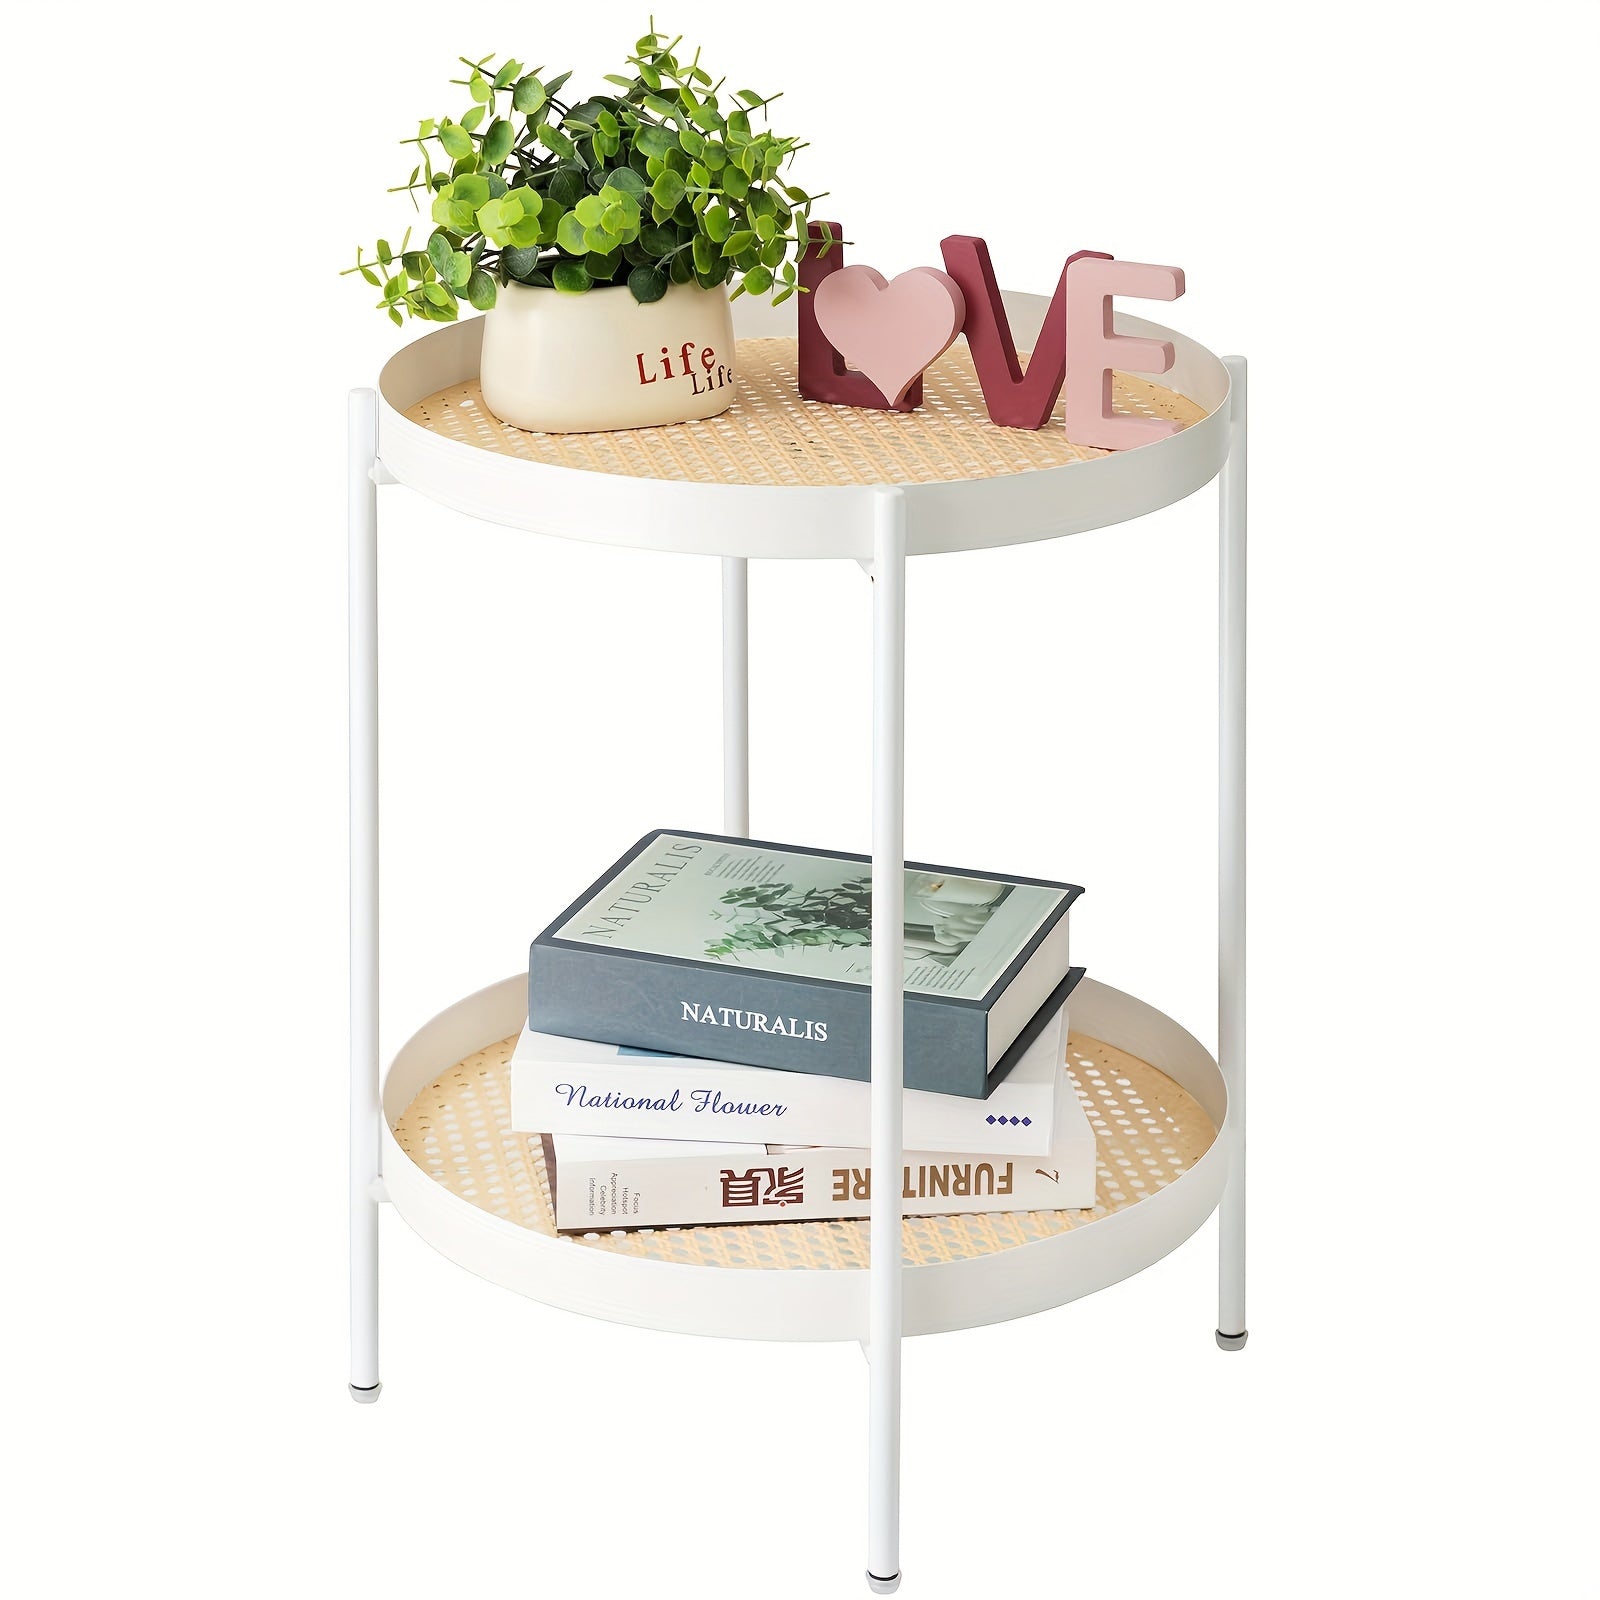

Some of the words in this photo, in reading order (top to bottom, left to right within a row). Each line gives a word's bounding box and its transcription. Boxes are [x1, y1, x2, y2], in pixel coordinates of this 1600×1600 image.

[636, 342, 716, 385] Life
[691, 365, 733, 396] Life
[581, 843, 703, 939] NATURALIS
[680, 1001, 829, 1042] NATURALIS
[555, 1083, 684, 1112] National
[690, 1089, 788, 1117] Flower
[598, 1184, 607, 1216] Celebrity
[610, 1172, 618, 1215] Appreciation
[621, 1187, 629, 1215] Hotspot
[720, 1166, 805, 1208] 家具
[832, 1162, 1014, 1201] FURNITRE
[633, 1192, 641, 1214] Focus
